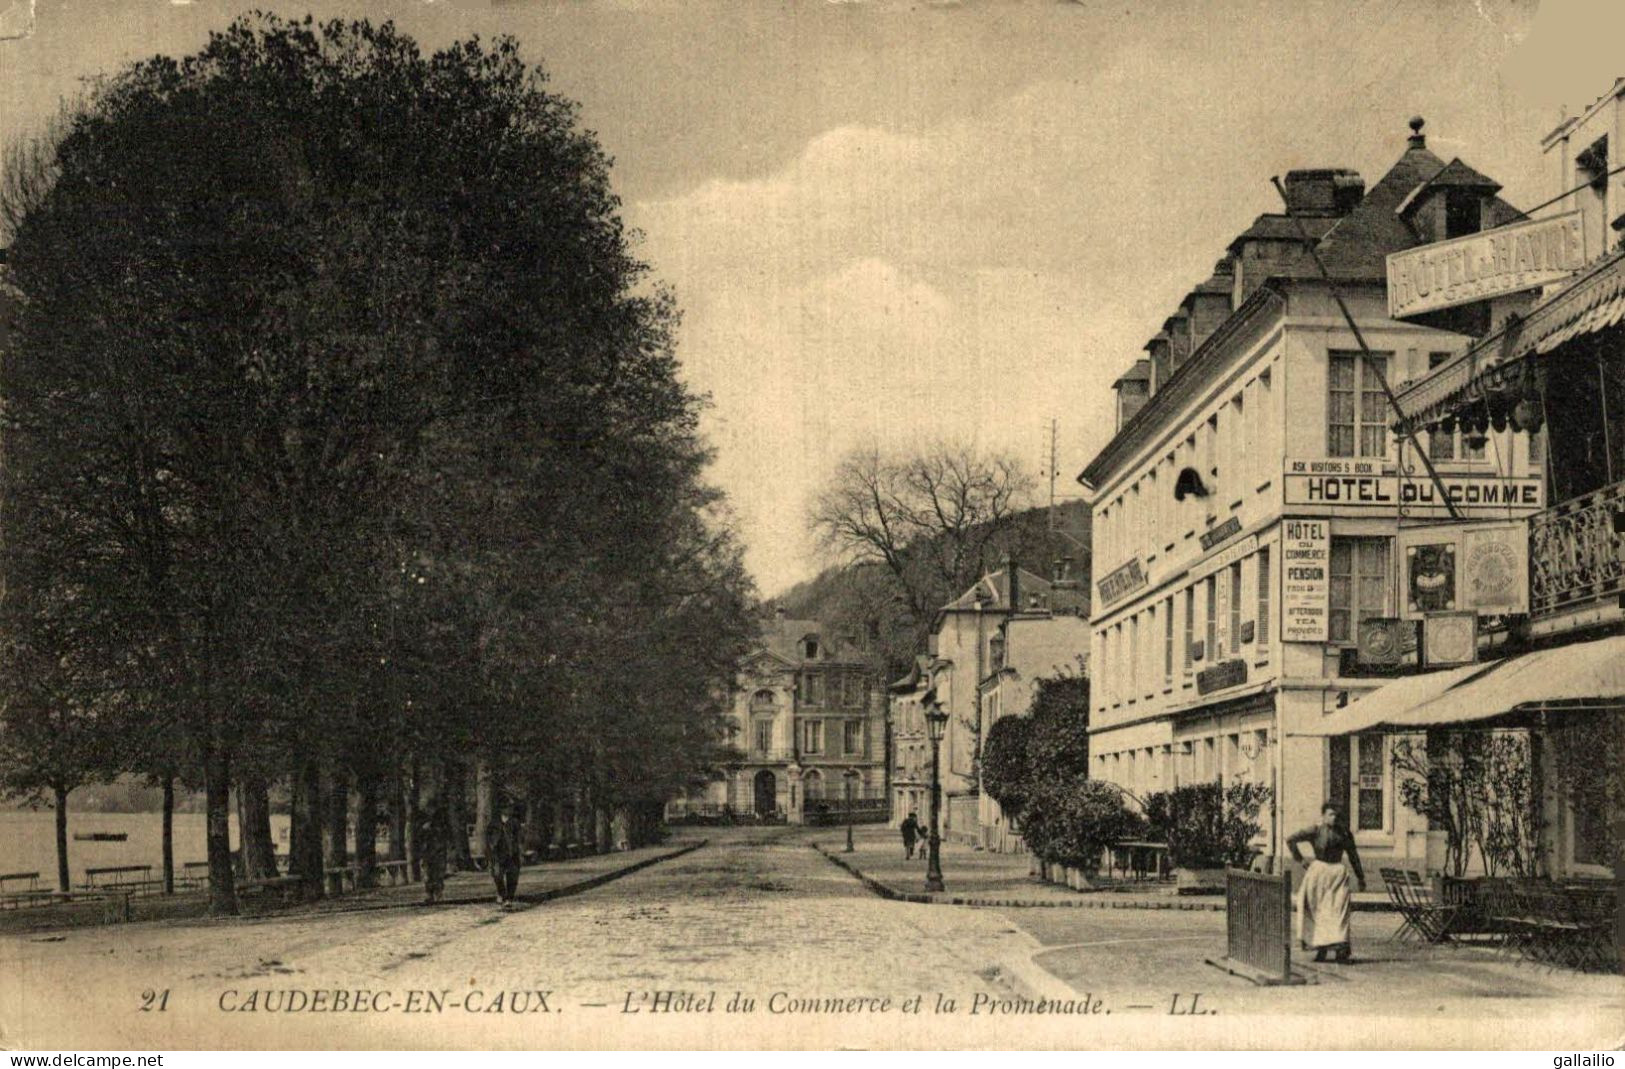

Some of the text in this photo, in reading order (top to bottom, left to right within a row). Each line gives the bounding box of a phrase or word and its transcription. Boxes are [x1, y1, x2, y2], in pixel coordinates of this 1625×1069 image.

[1490, 221, 1583, 275] HAVRE
[1292, 462, 1306, 472] ASK
[1355, 463, 1373, 473] BOOK
[1403, 484, 1434, 502] DU
[1448, 485, 1538, 503] COMME
[1287, 521, 1325, 540] HÔTEL
[1285, 549, 1327, 560] COMMERCE
[1288, 567, 1324, 580] PENSION
